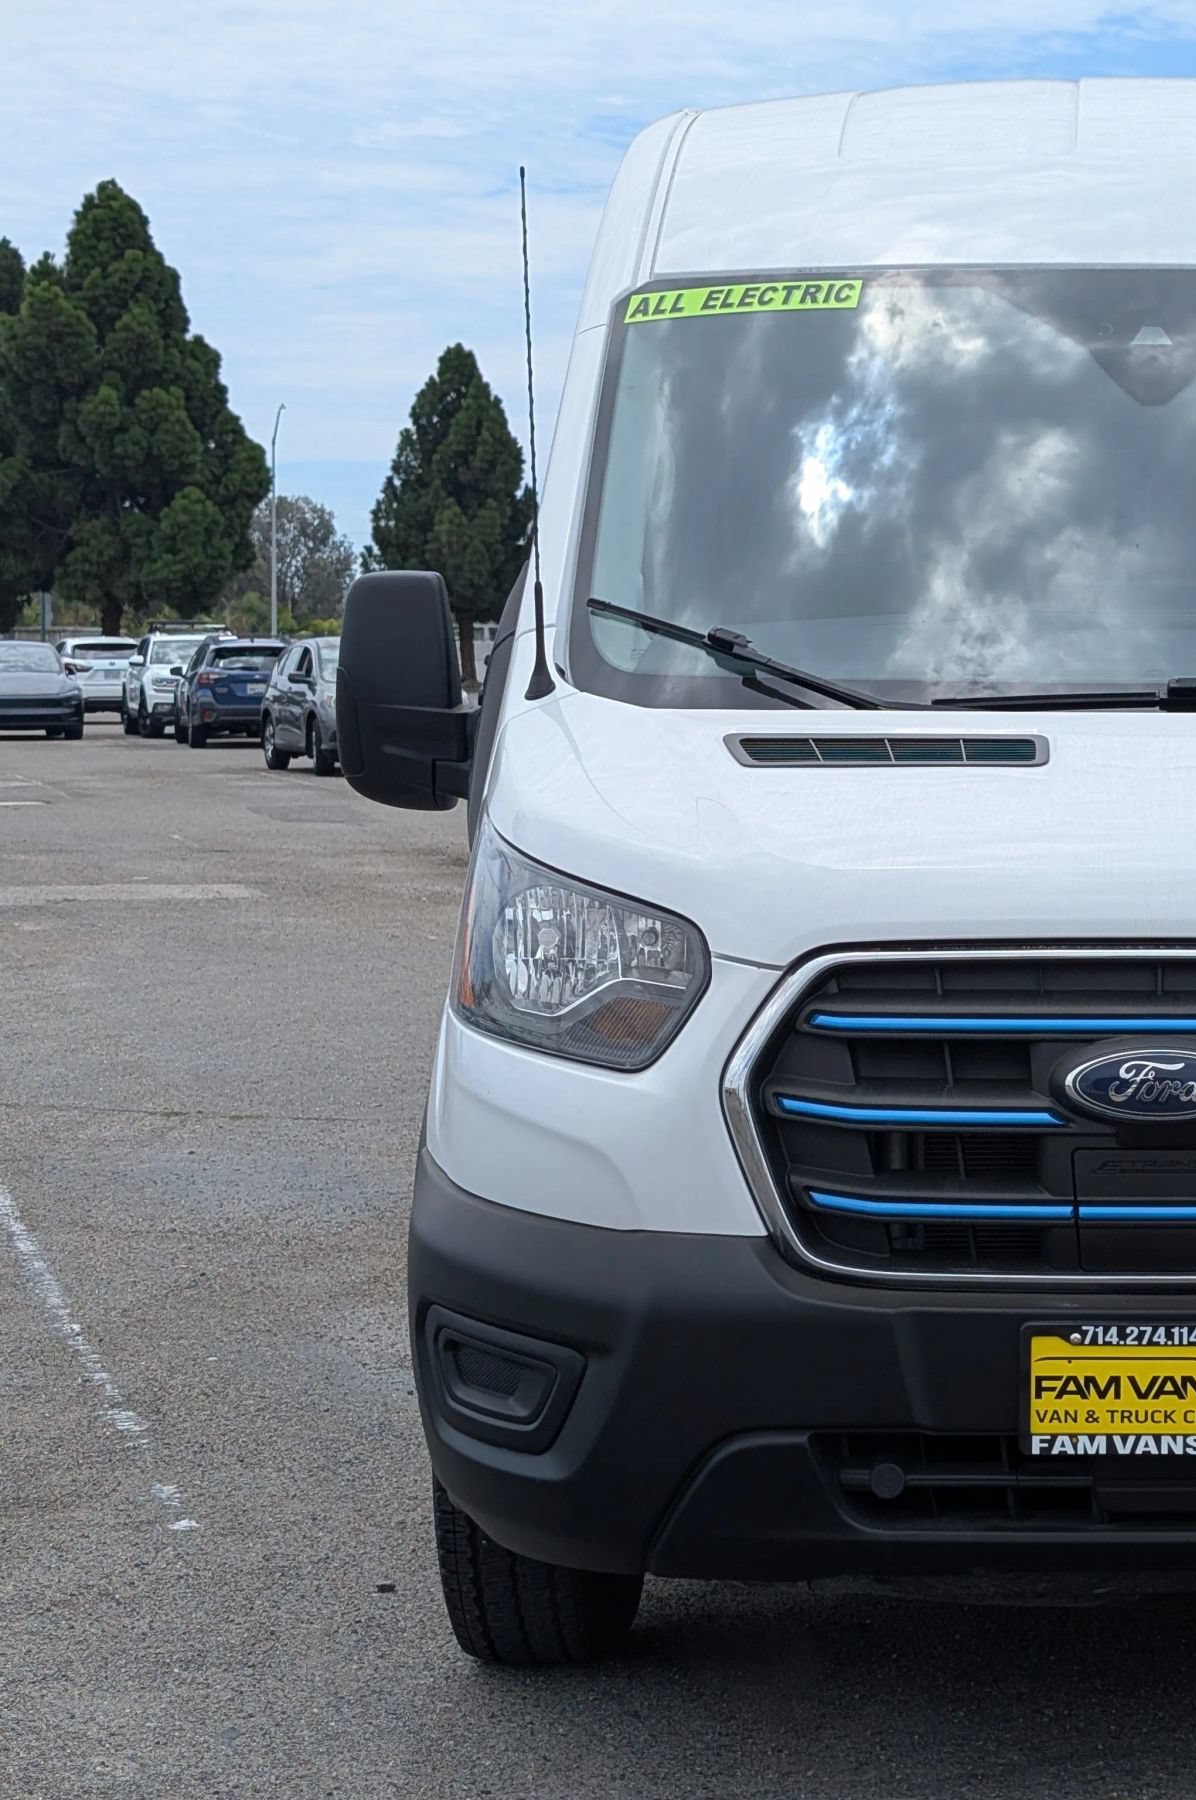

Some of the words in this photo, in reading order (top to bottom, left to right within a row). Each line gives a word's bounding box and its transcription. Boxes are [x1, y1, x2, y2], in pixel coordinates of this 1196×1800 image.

[628, 293, 686, 318] ALL
[700, 283, 856, 310] ELECTRIC
[1034, 1375, 1121, 1400] FAM
[1035, 1409, 1078, 1423] VAN
[1085, 1409, 1100, 1423] &
[1106, 1409, 1176, 1423] TRUCK
